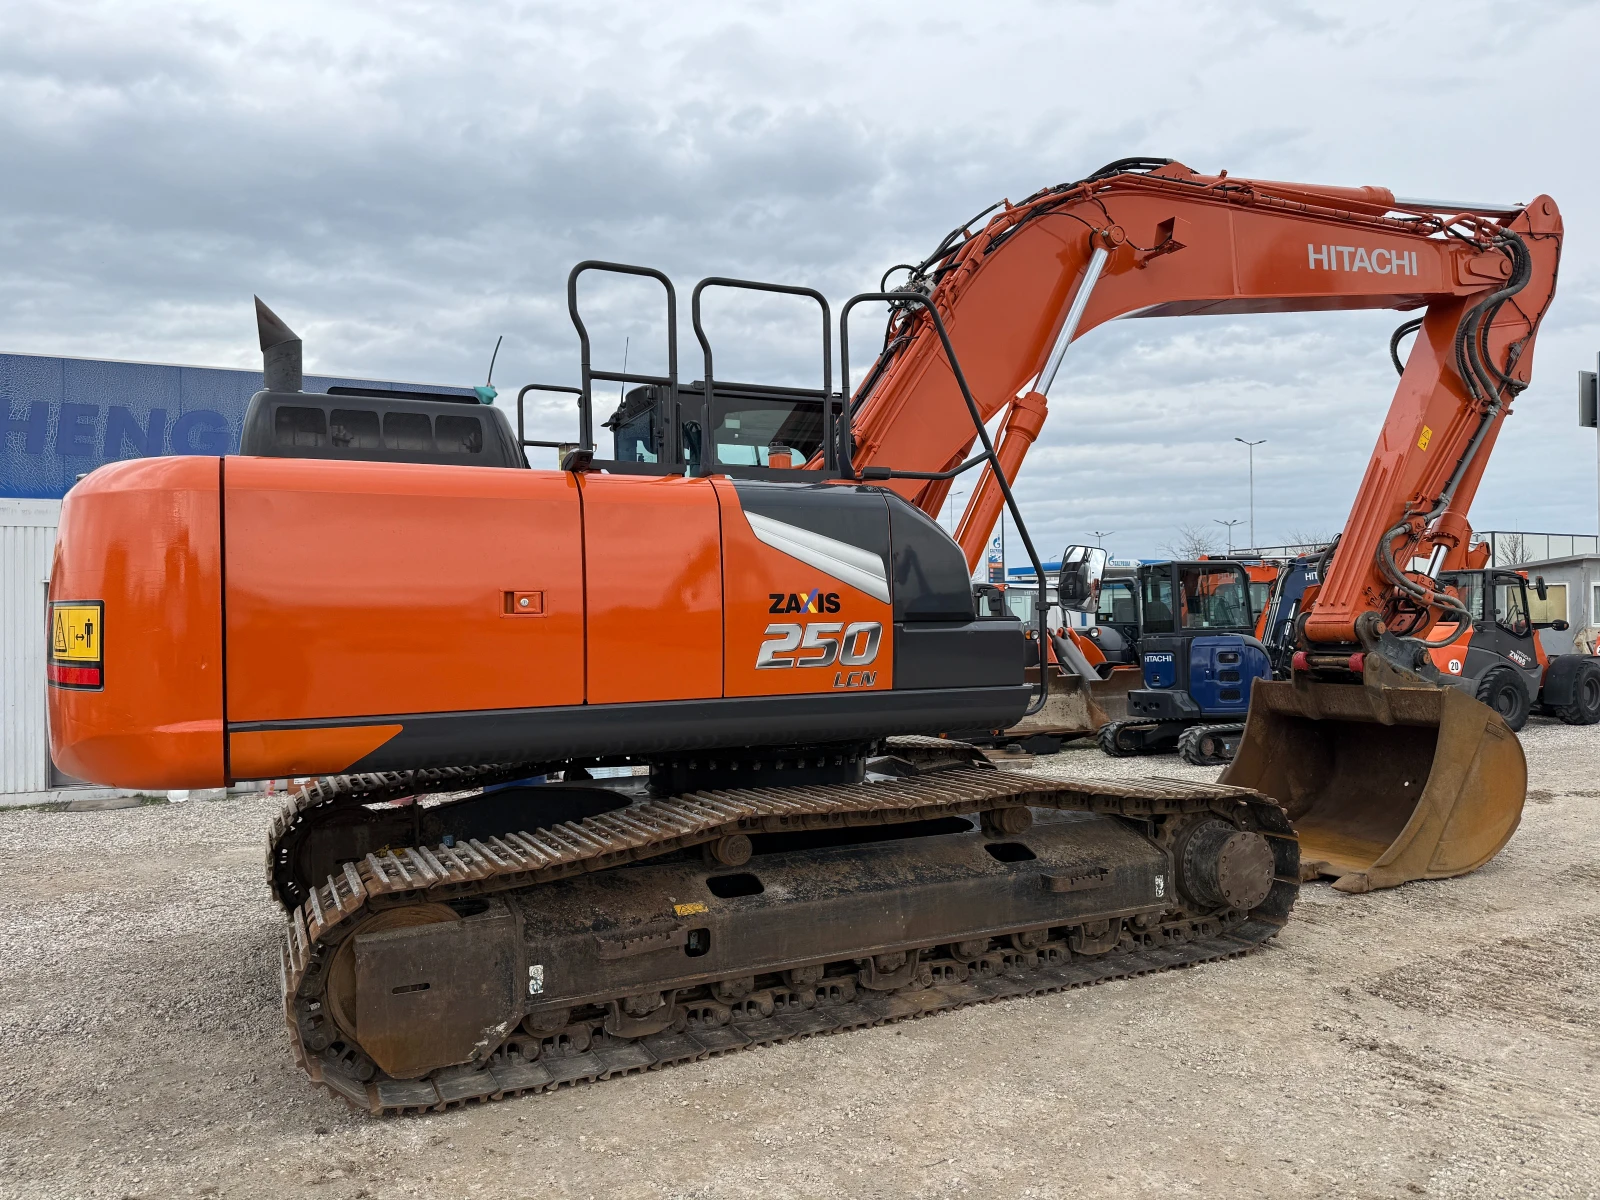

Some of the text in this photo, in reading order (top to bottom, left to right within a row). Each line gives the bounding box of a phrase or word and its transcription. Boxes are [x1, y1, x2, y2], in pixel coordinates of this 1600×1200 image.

[1307, 243, 1418, 276] HITACHI
[768, 588, 841, 614] ZAXIS
[754, 621, 883, 670] 250
[1144, 655, 1172, 663] HITACHI
[1450, 661, 1459, 671] 20
[1509, 650, 1527, 666] ZW95
[832, 670, 877, 688] LCN
